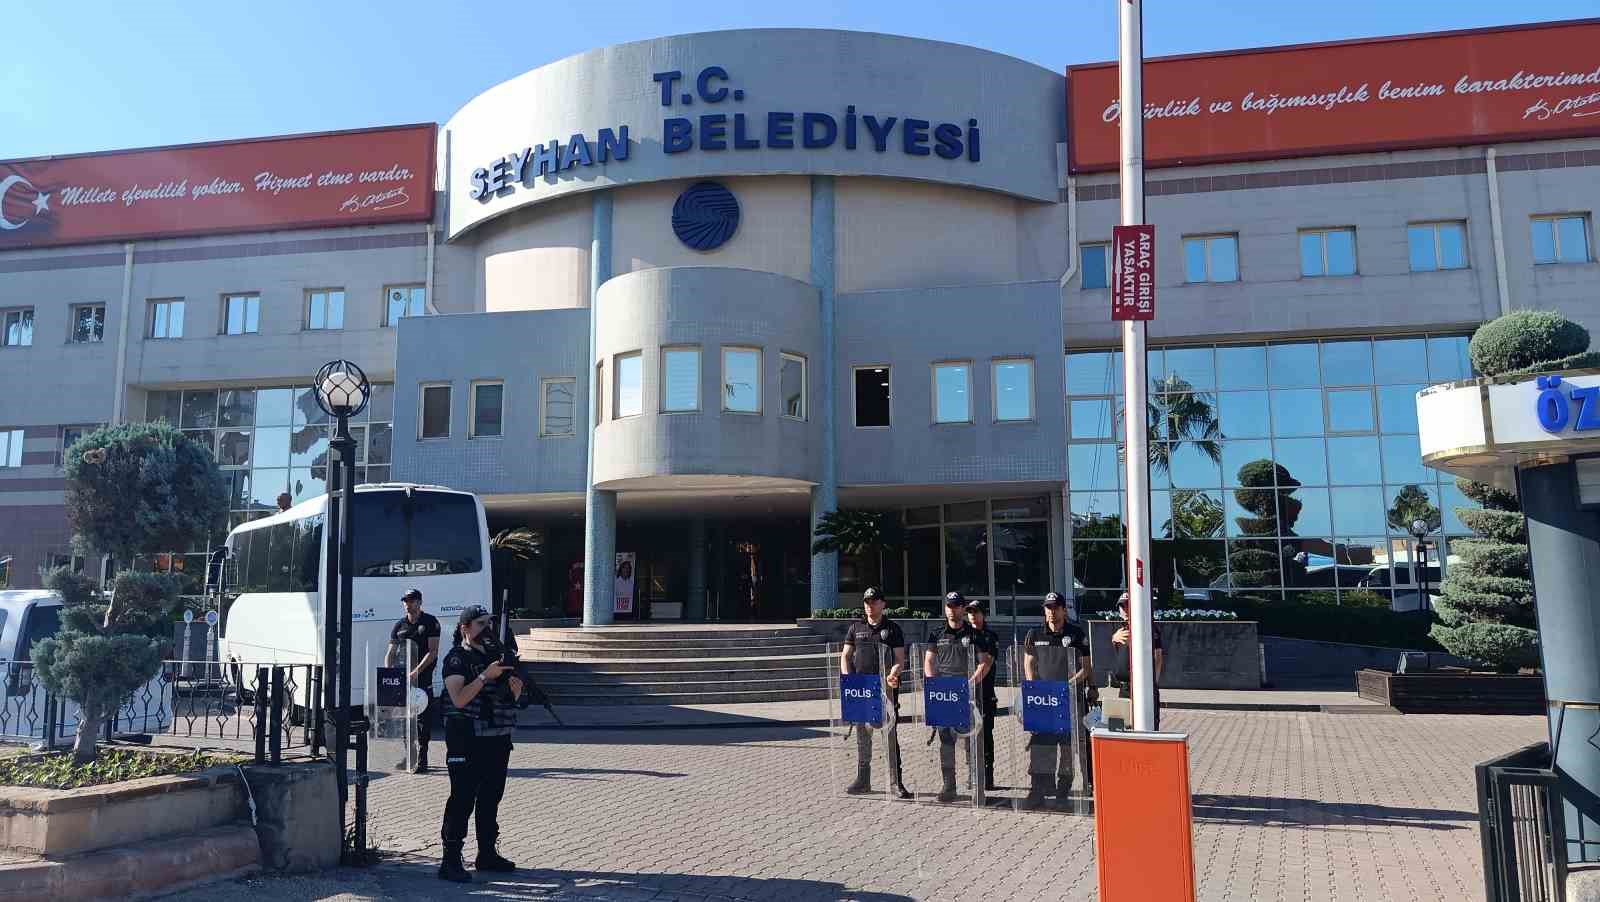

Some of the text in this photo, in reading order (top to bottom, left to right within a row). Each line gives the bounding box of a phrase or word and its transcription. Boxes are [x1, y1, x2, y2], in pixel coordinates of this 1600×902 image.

[653, 66, 745, 107] T.C.
[1102, 97, 1202, 127] Öürlük
[1209, 101, 1233, 113] ve
[1241, 84, 1370, 115] bağımsızlık
[1378, 81, 1446, 100] benim
[469, 105, 981, 201] SEYHAN BELEDİYESİ
[60, 163, 414, 206] Millete efendilik yoktur. Hizmet etme vardır.
[1123, 240, 1136, 307] YASAKTIR
[1136, 232, 1153, 313] ARAÇ GİRİŞİ
[389, 563, 438, 573] ISUZU
[844, 688, 871, 698] POLİS
[929, 690, 958, 702] POLİS
[1027, 695, 1058, 707] POLİS
